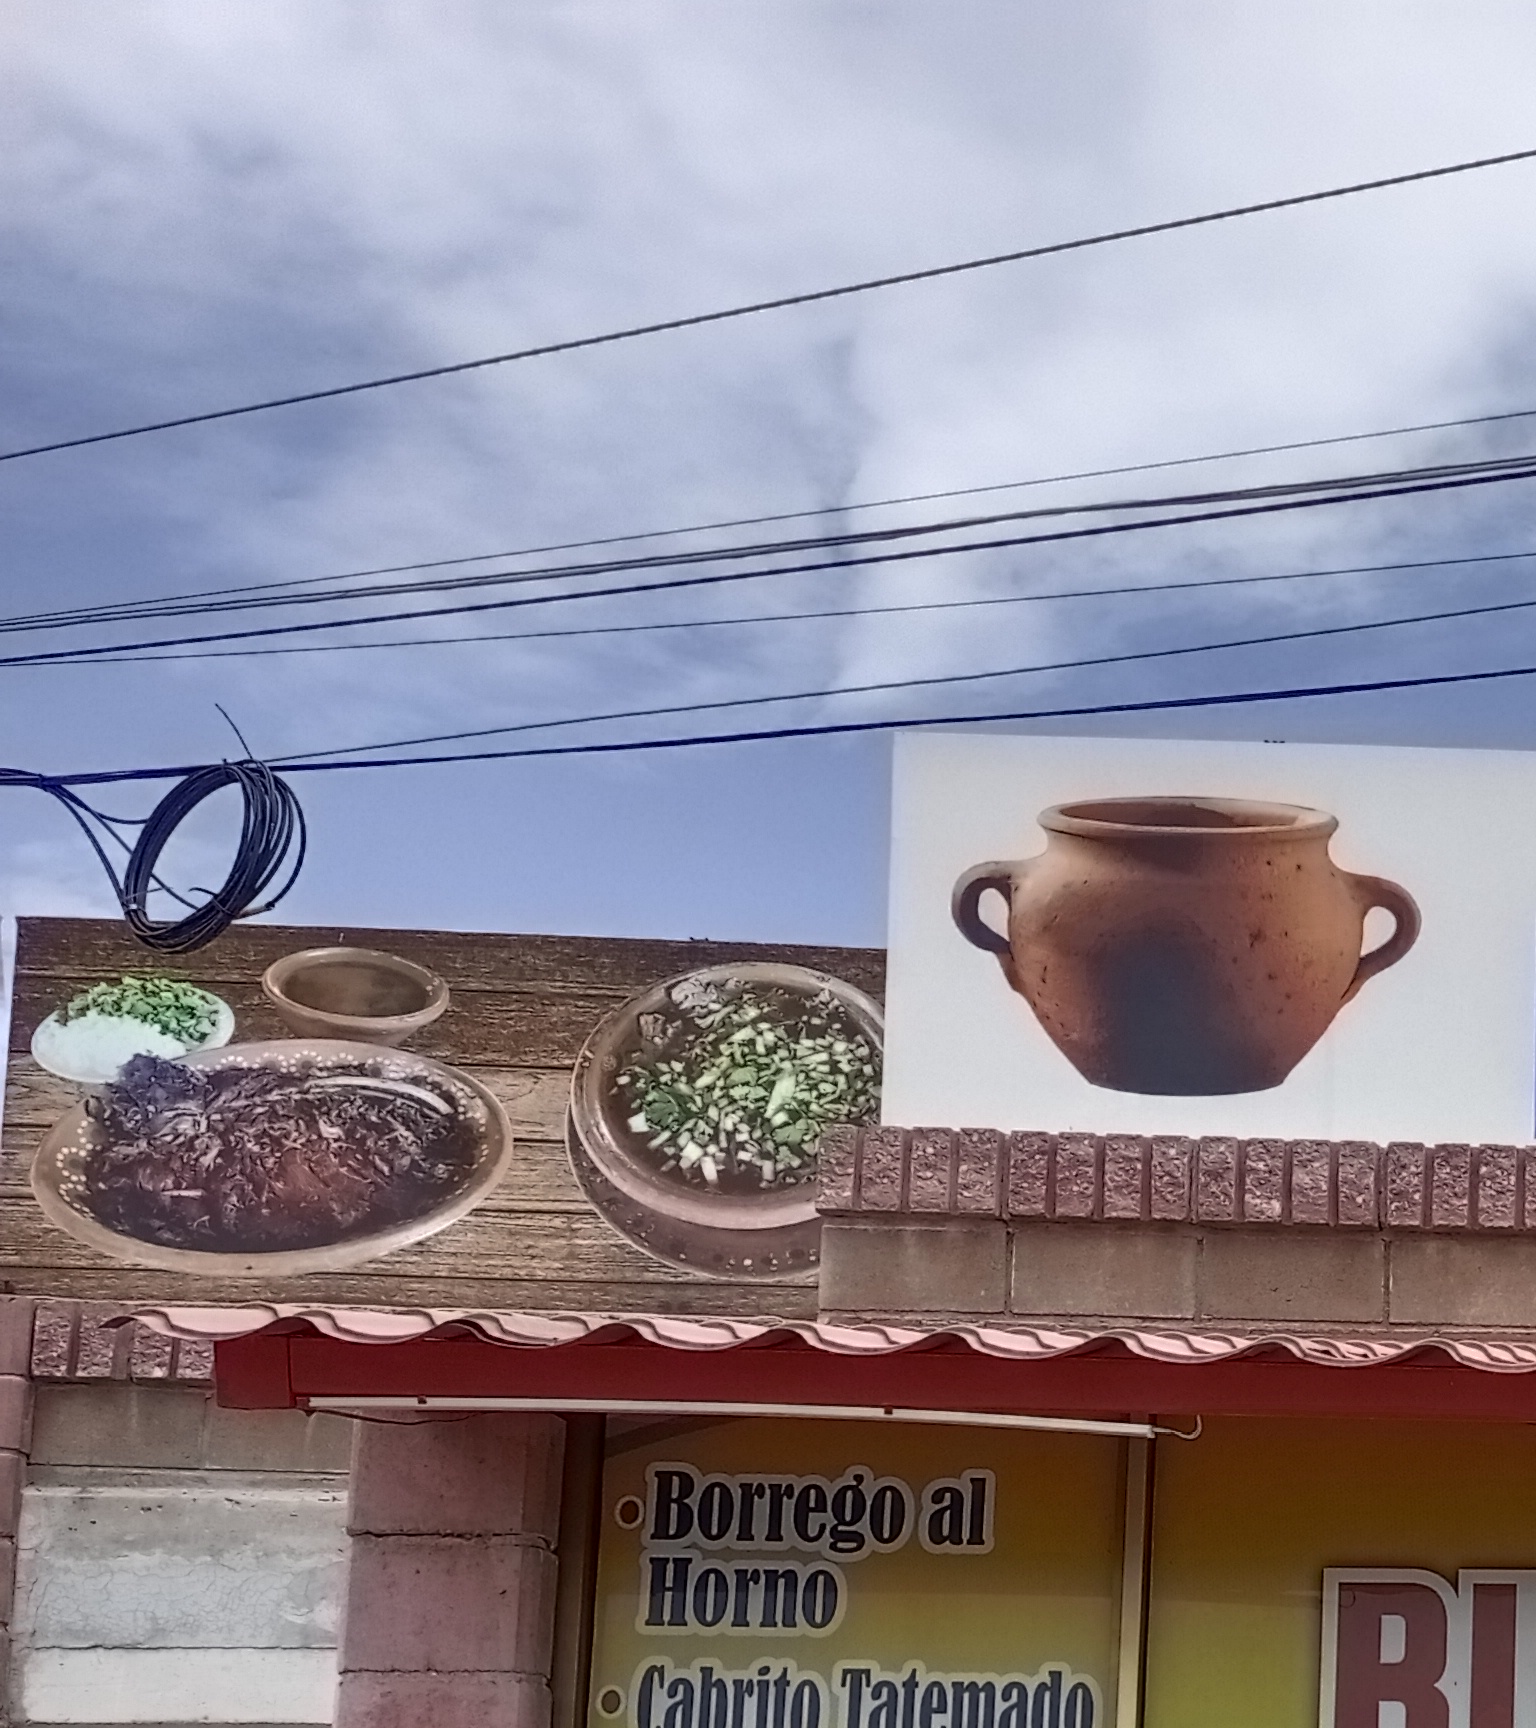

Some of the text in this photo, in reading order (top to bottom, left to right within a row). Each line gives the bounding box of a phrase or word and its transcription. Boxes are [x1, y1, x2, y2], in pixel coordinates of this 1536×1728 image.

[648, 1469, 987, 1554] Borrego al
[644, 1556, 839, 1630] Horno
